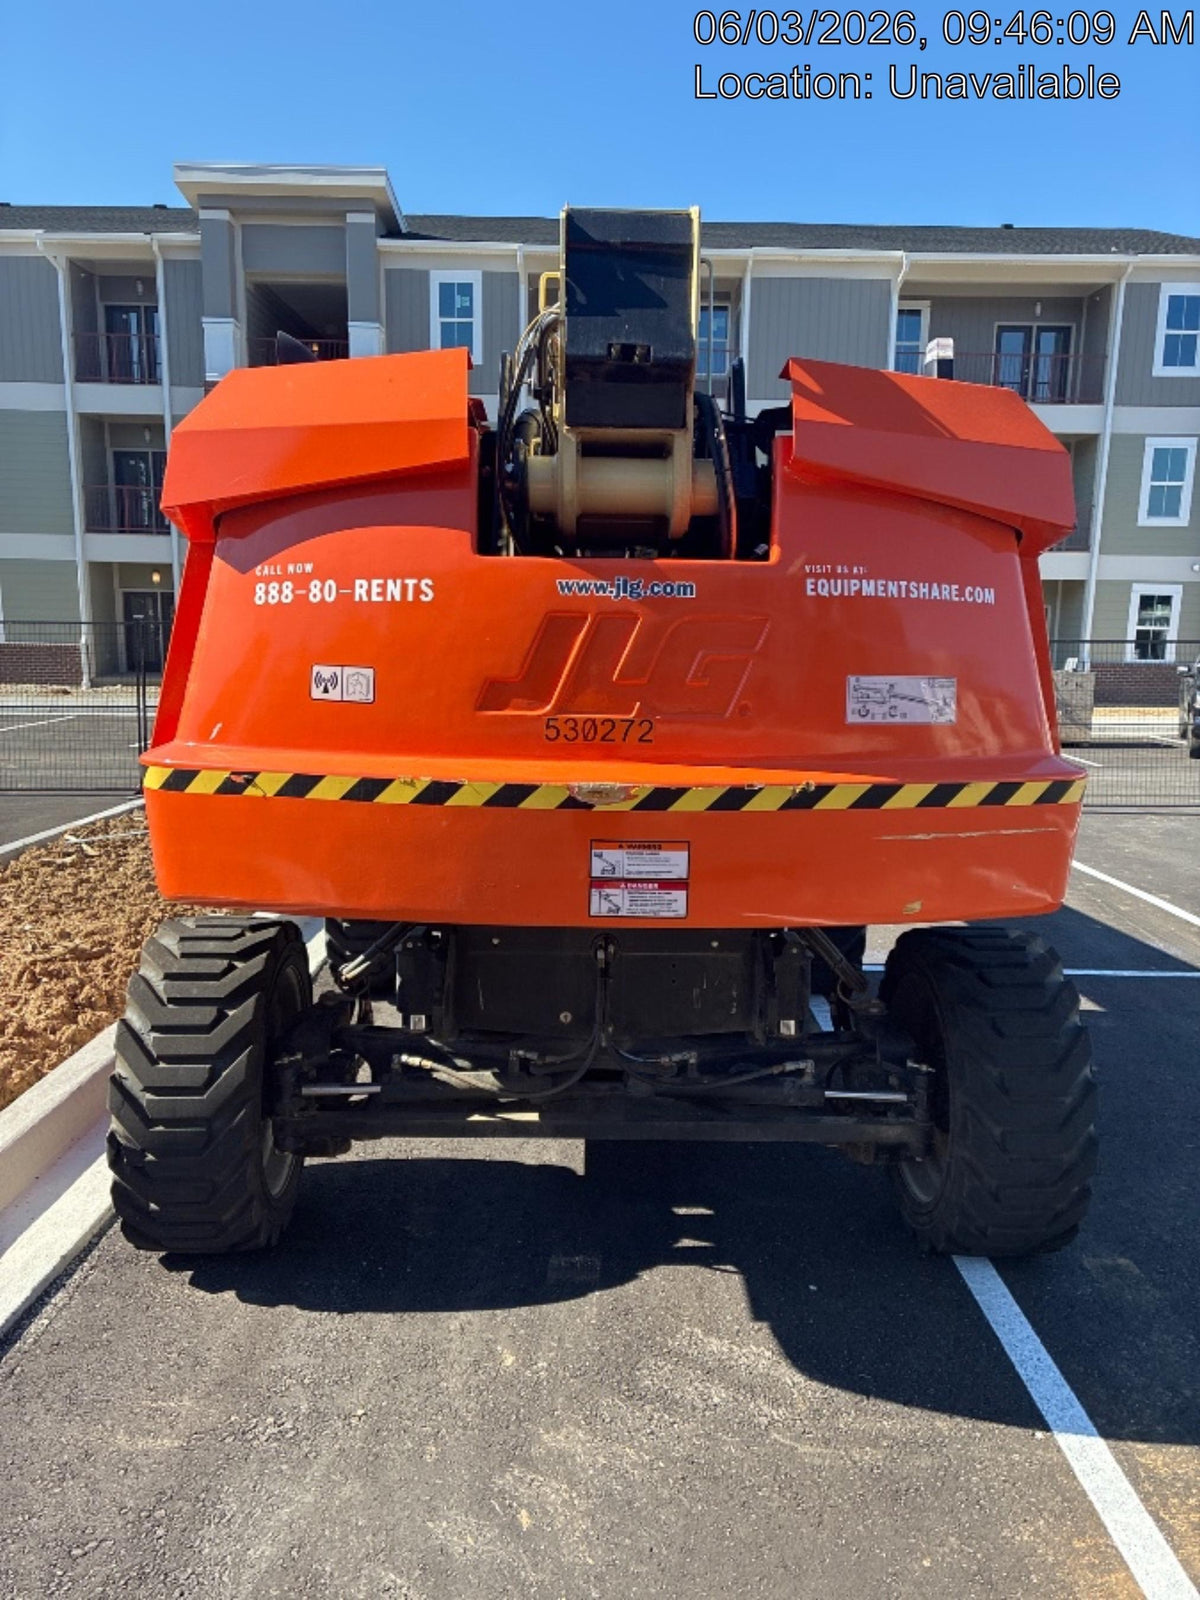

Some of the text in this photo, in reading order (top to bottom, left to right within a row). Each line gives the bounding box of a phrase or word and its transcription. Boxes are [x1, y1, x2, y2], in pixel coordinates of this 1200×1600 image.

[255, 562, 314, 576] CALL NOW
[804, 564, 832, 574] VISIT
[254, 578, 434, 605] 888-80-RENTS
[556, 577, 696, 600] www.jlg.com
[806, 578, 995, 605] EQUIPMENTSHARE.COM
[475, 611, 770, 718] JLG
[544, 717, 654, 743] 530272
